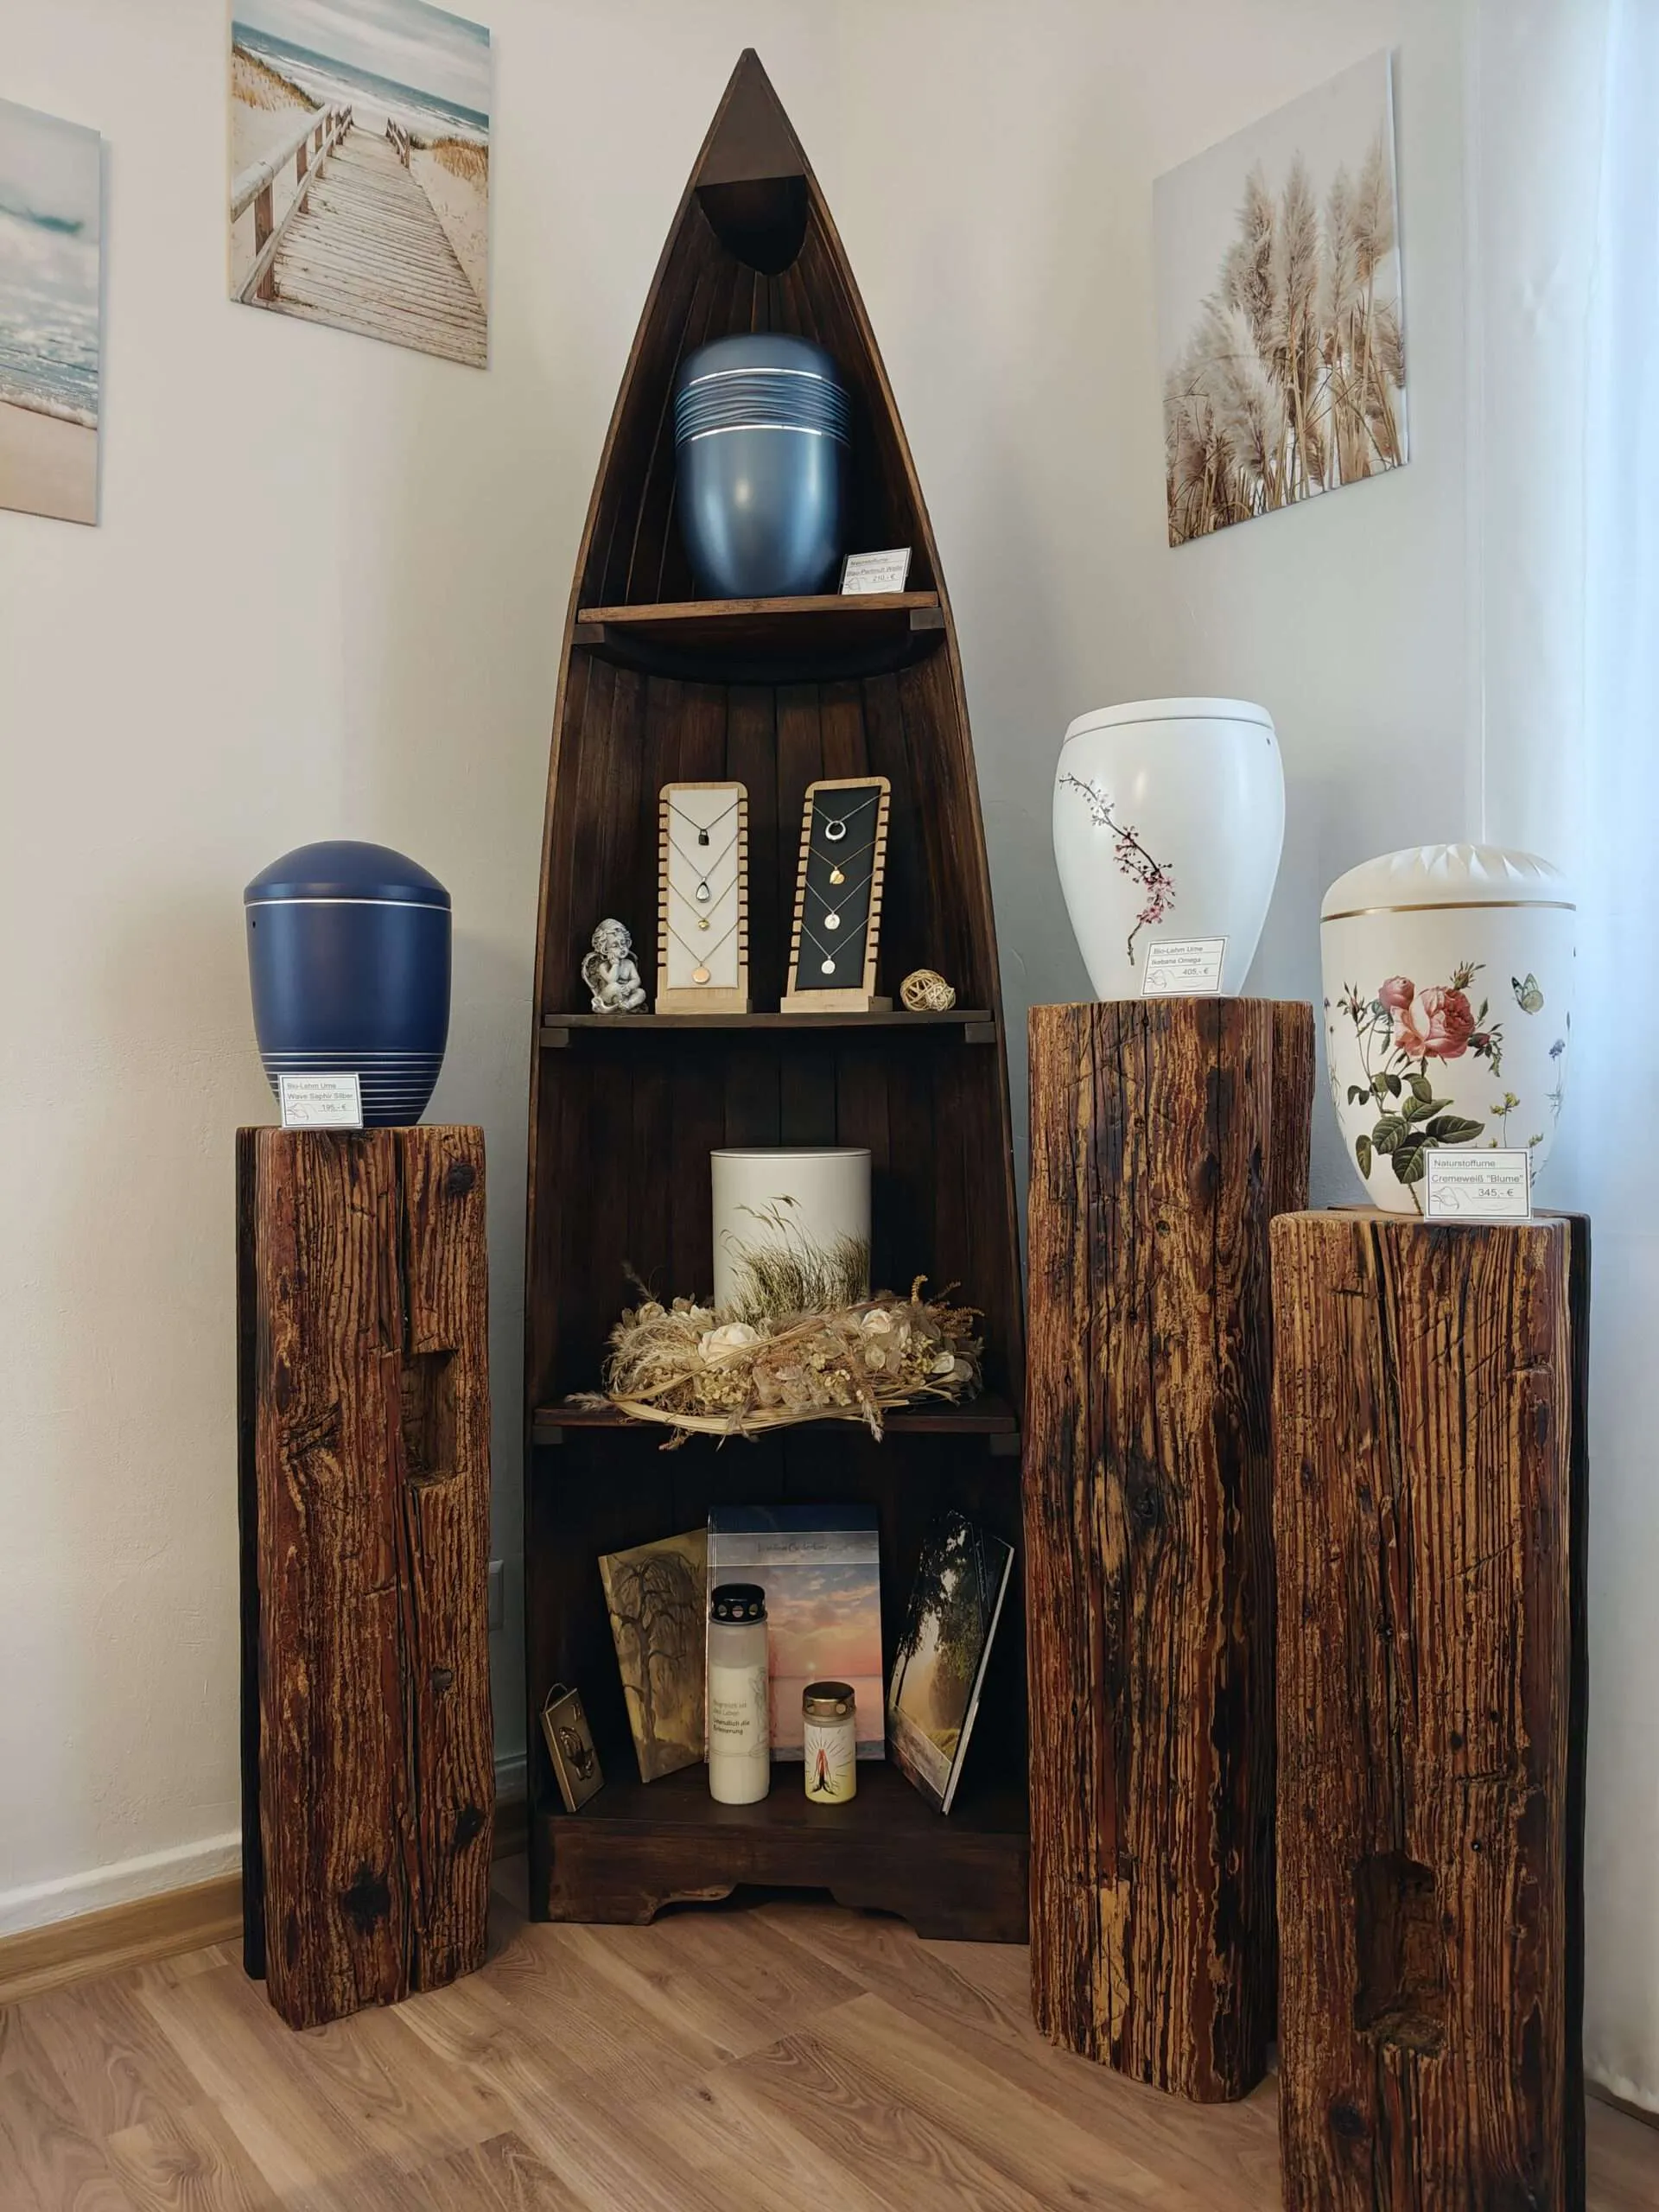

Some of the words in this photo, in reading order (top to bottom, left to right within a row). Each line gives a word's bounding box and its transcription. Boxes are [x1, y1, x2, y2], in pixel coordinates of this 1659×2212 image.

[1431, 1174, 1484, 1183] Cremeweiß
[1487, 1174, 1523, 1183] "Blume"
[1478, 1188, 1504, 1198] 345,-
[1507, 1188, 1514, 1197] €
